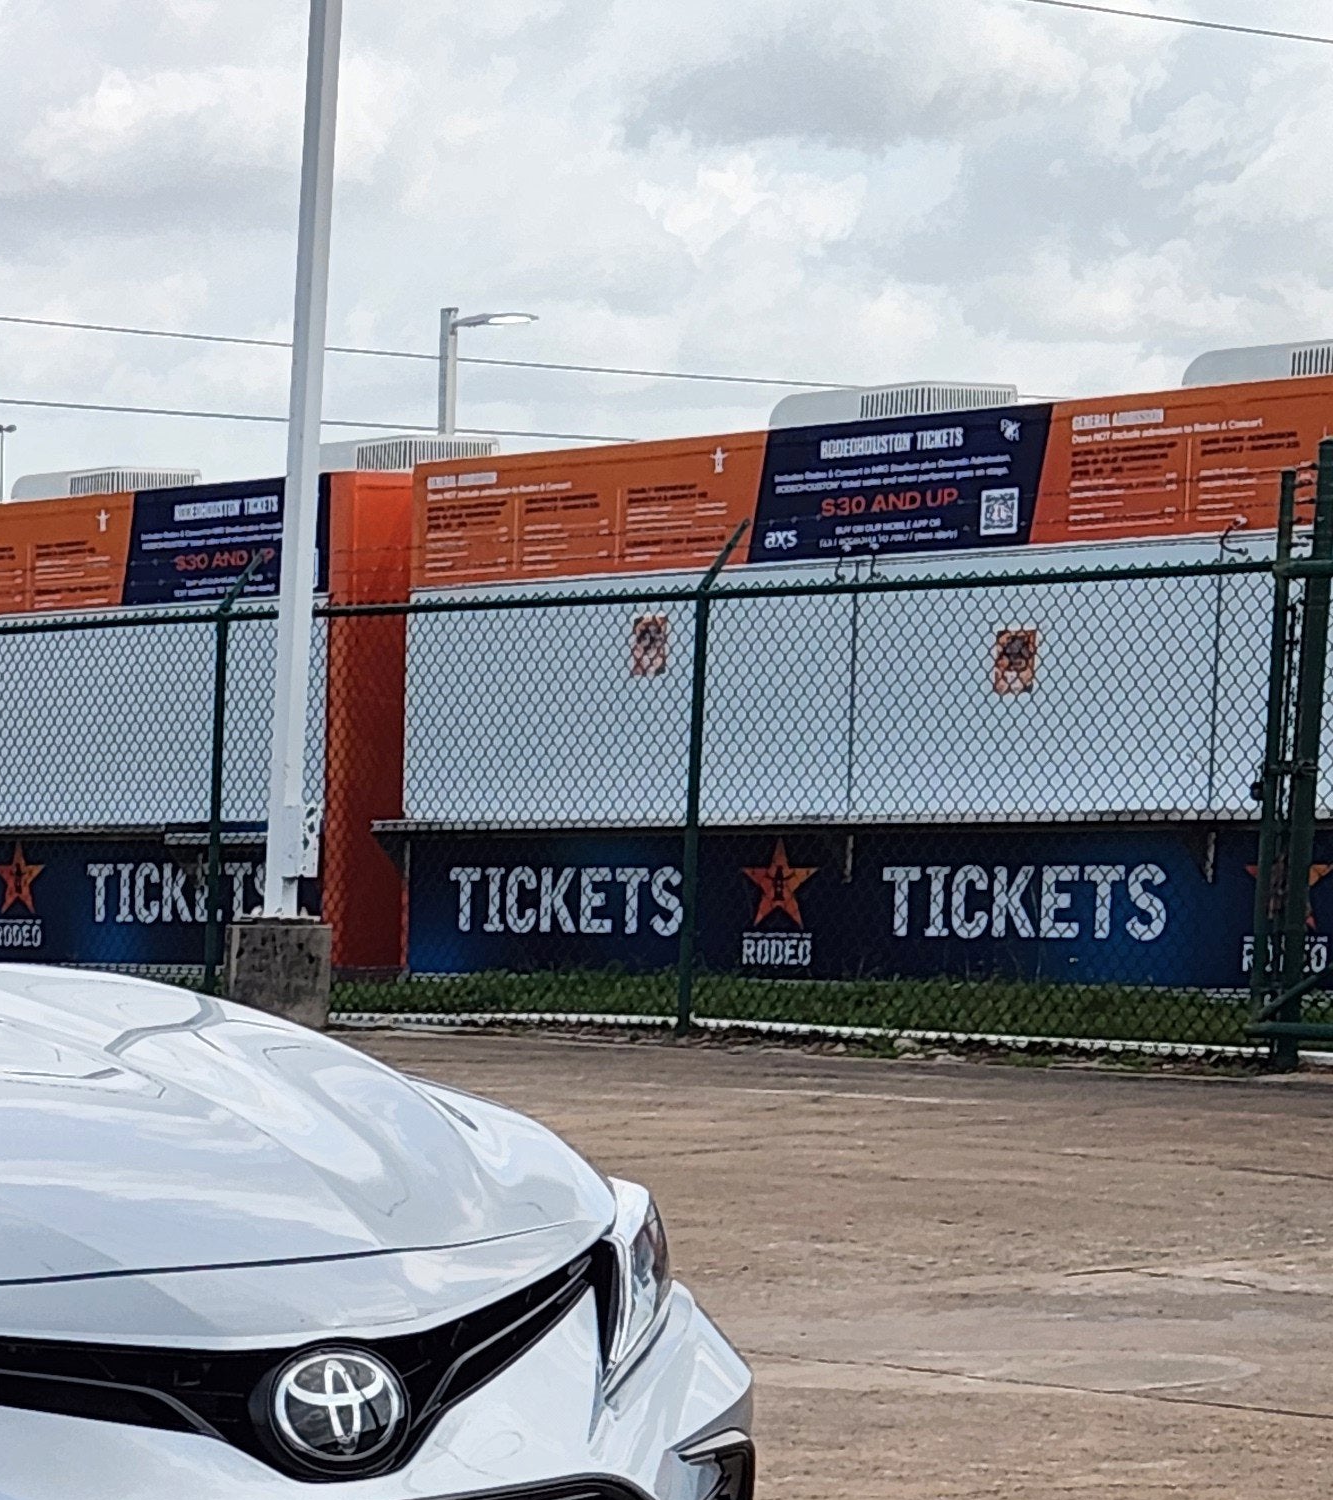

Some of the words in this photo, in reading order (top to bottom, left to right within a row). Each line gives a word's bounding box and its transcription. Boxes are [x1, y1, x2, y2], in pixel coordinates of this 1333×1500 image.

[916, 427, 964, 450] TICKETS
[870, 490, 922, 513] AND
[926, 487, 959, 506] UP
[212, 550, 248, 568] AND
[449, 866, 684, 937] TICKETS
[882, 863, 1167, 941] TICKETS
[742, 939, 812, 966] RODEO
